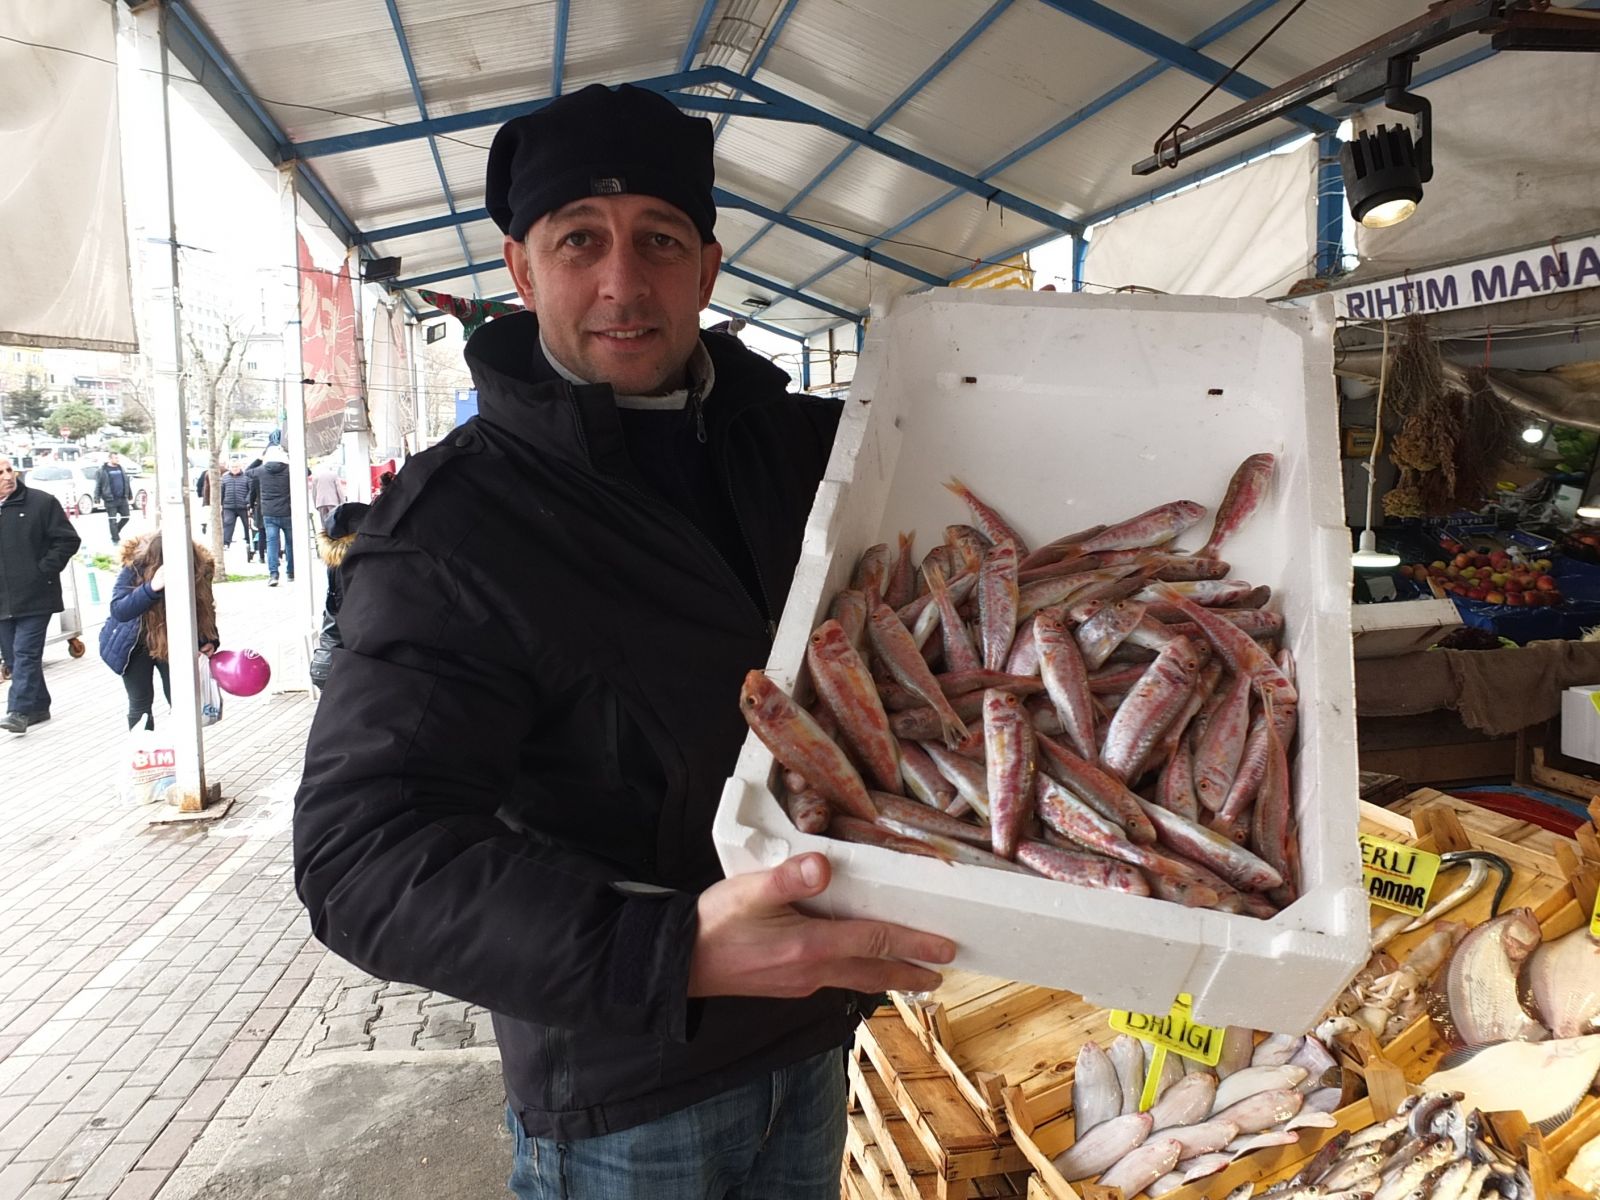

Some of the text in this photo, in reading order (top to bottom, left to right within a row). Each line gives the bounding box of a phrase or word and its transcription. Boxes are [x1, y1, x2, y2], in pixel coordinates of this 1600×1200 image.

[1345, 247, 1600, 319] RIHTIM MANA
[1359, 836, 1417, 875] ERLİ
[1362, 875, 1426, 909] AMAR
